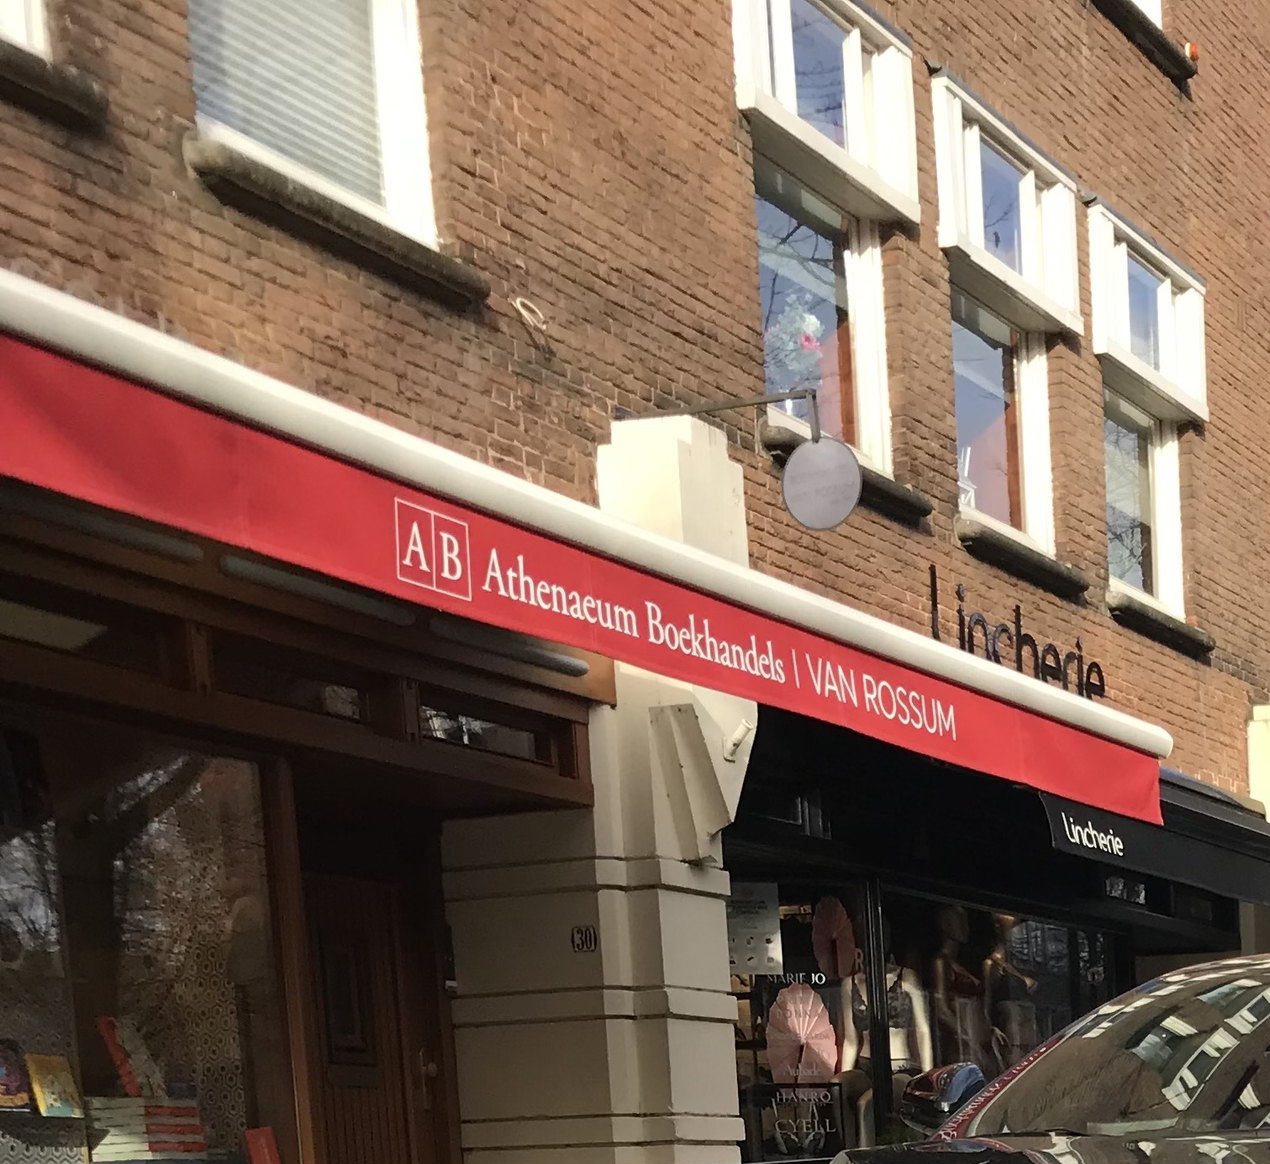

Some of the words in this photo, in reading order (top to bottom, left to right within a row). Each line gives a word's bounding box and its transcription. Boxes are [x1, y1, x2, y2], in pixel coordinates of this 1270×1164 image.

[482, 547, 640, 638] Athenaeum
[645, 600, 786, 685] Boekhandels
[805, 652, 859, 706] VAN
[862, 673, 957, 741] ROSSUM
[1061, 811, 1124, 857] Lincherie
[811, 972, 827, 985] JO
[776, 1091, 831, 1103] HANRO
[775, 1118, 836, 1133] CYELL
